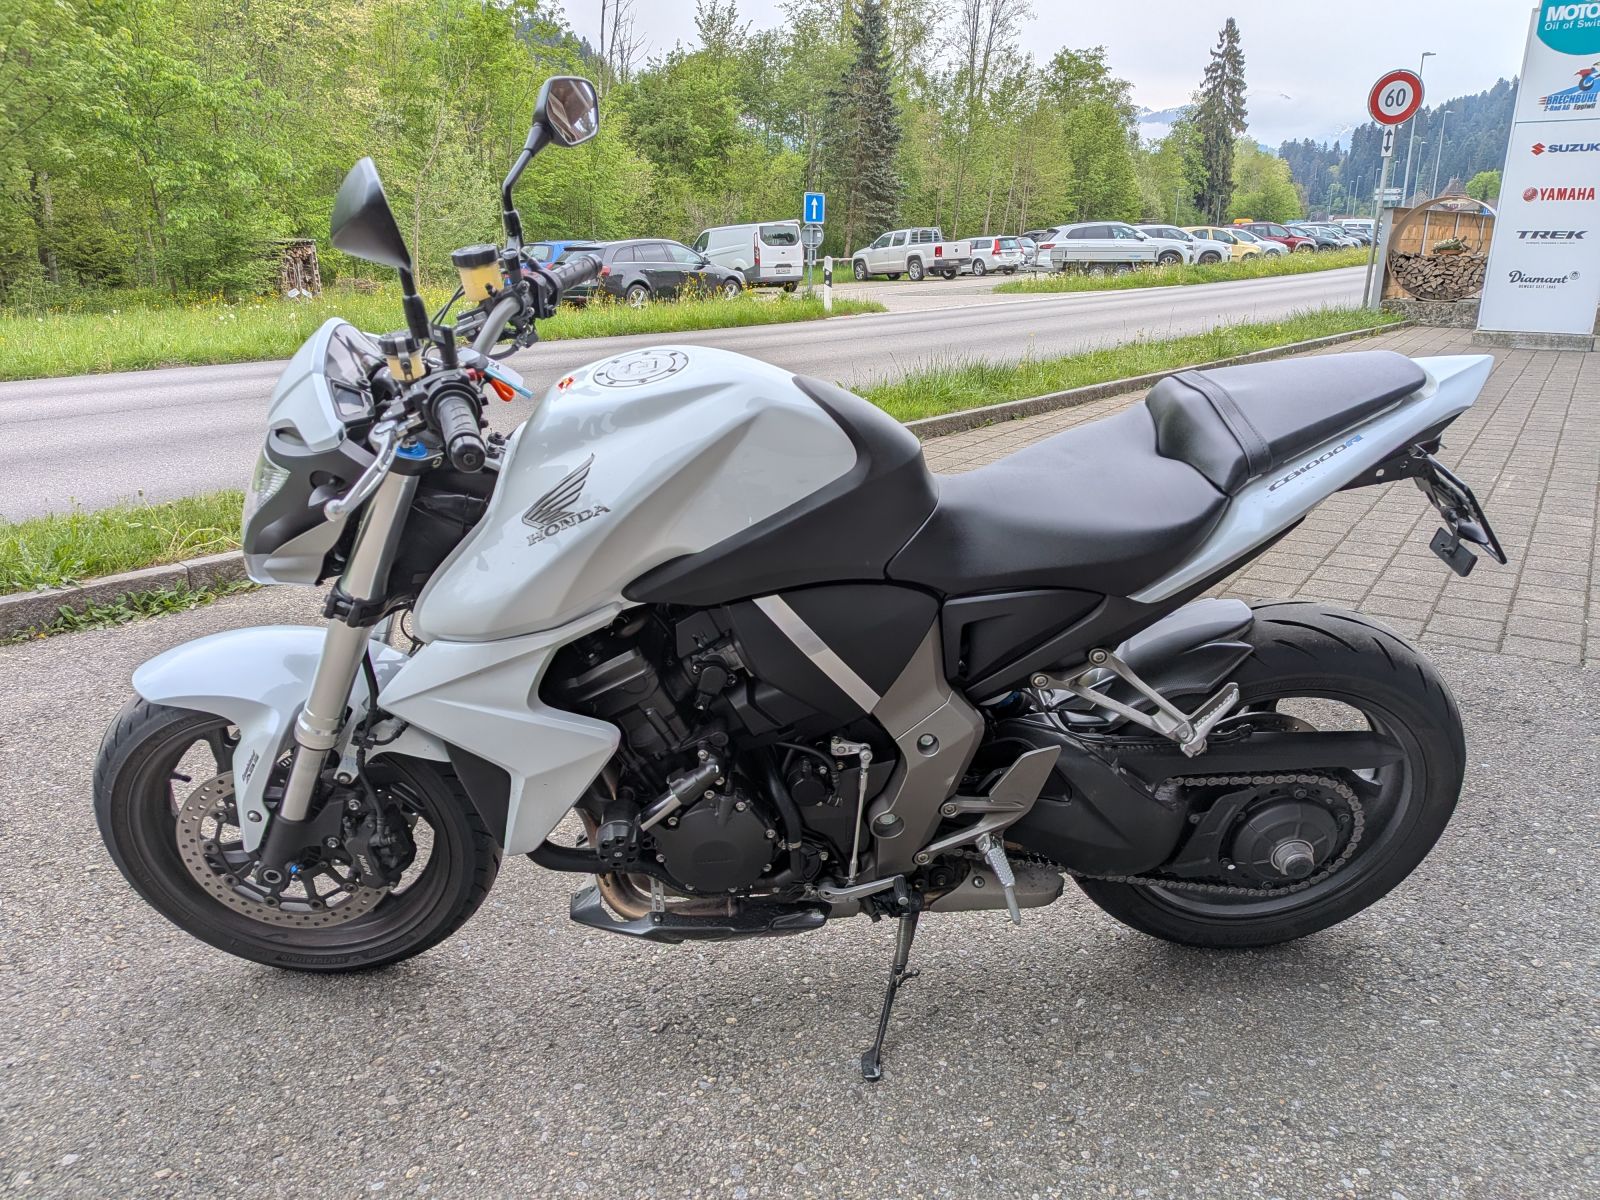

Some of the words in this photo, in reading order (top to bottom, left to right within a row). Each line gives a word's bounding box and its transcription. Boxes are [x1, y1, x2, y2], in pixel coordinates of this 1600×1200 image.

[1544, 21, 1560, 31] Oil
[1563, 20, 1575, 29] of
[1384, 88, 1407, 108] 60
[1547, 143, 1600, 153] SUZUK
[1540, 187, 1596, 201] YAMAHA
[1515, 230, 1589, 240] TREK
[1508, 270, 1569, 284] Diamant
[1268, 434, 1364, 492] CB1000R
[526, 504, 611, 547] HONDA
